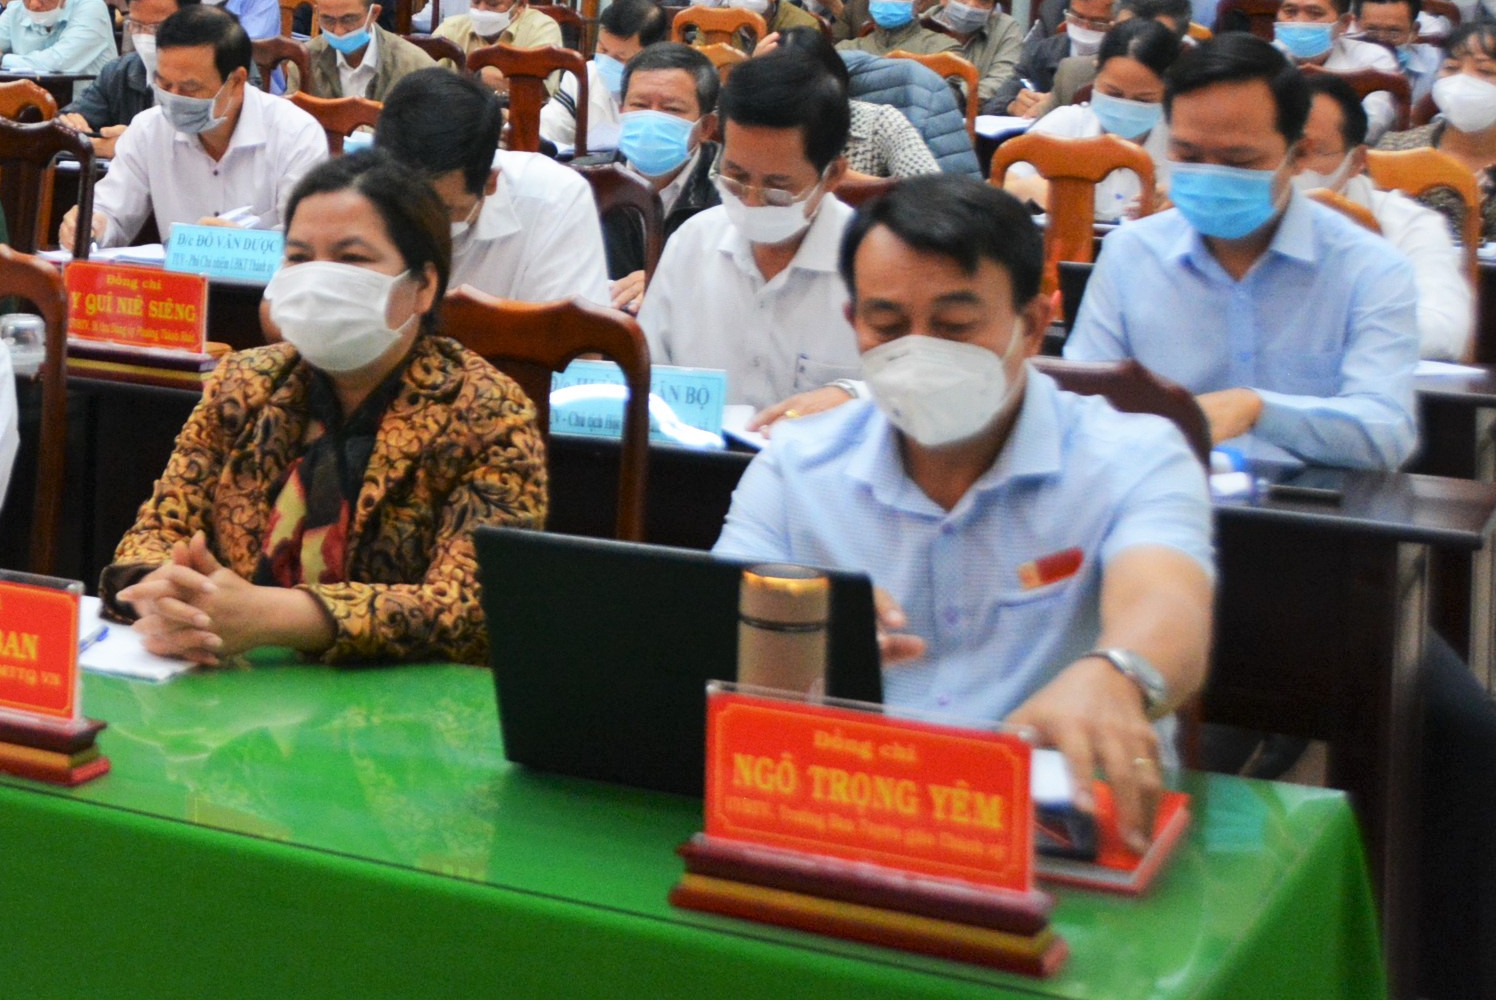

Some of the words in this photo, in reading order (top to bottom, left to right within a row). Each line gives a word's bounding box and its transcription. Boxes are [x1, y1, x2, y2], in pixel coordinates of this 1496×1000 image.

[217, 233, 241, 251] VĂN
[685, 385, 710, 410] BỘ
[732, 751, 800, 796] NGÔ
[808, 763, 919, 818] TRỌNG
[928, 779, 1004, 830] YÊM
